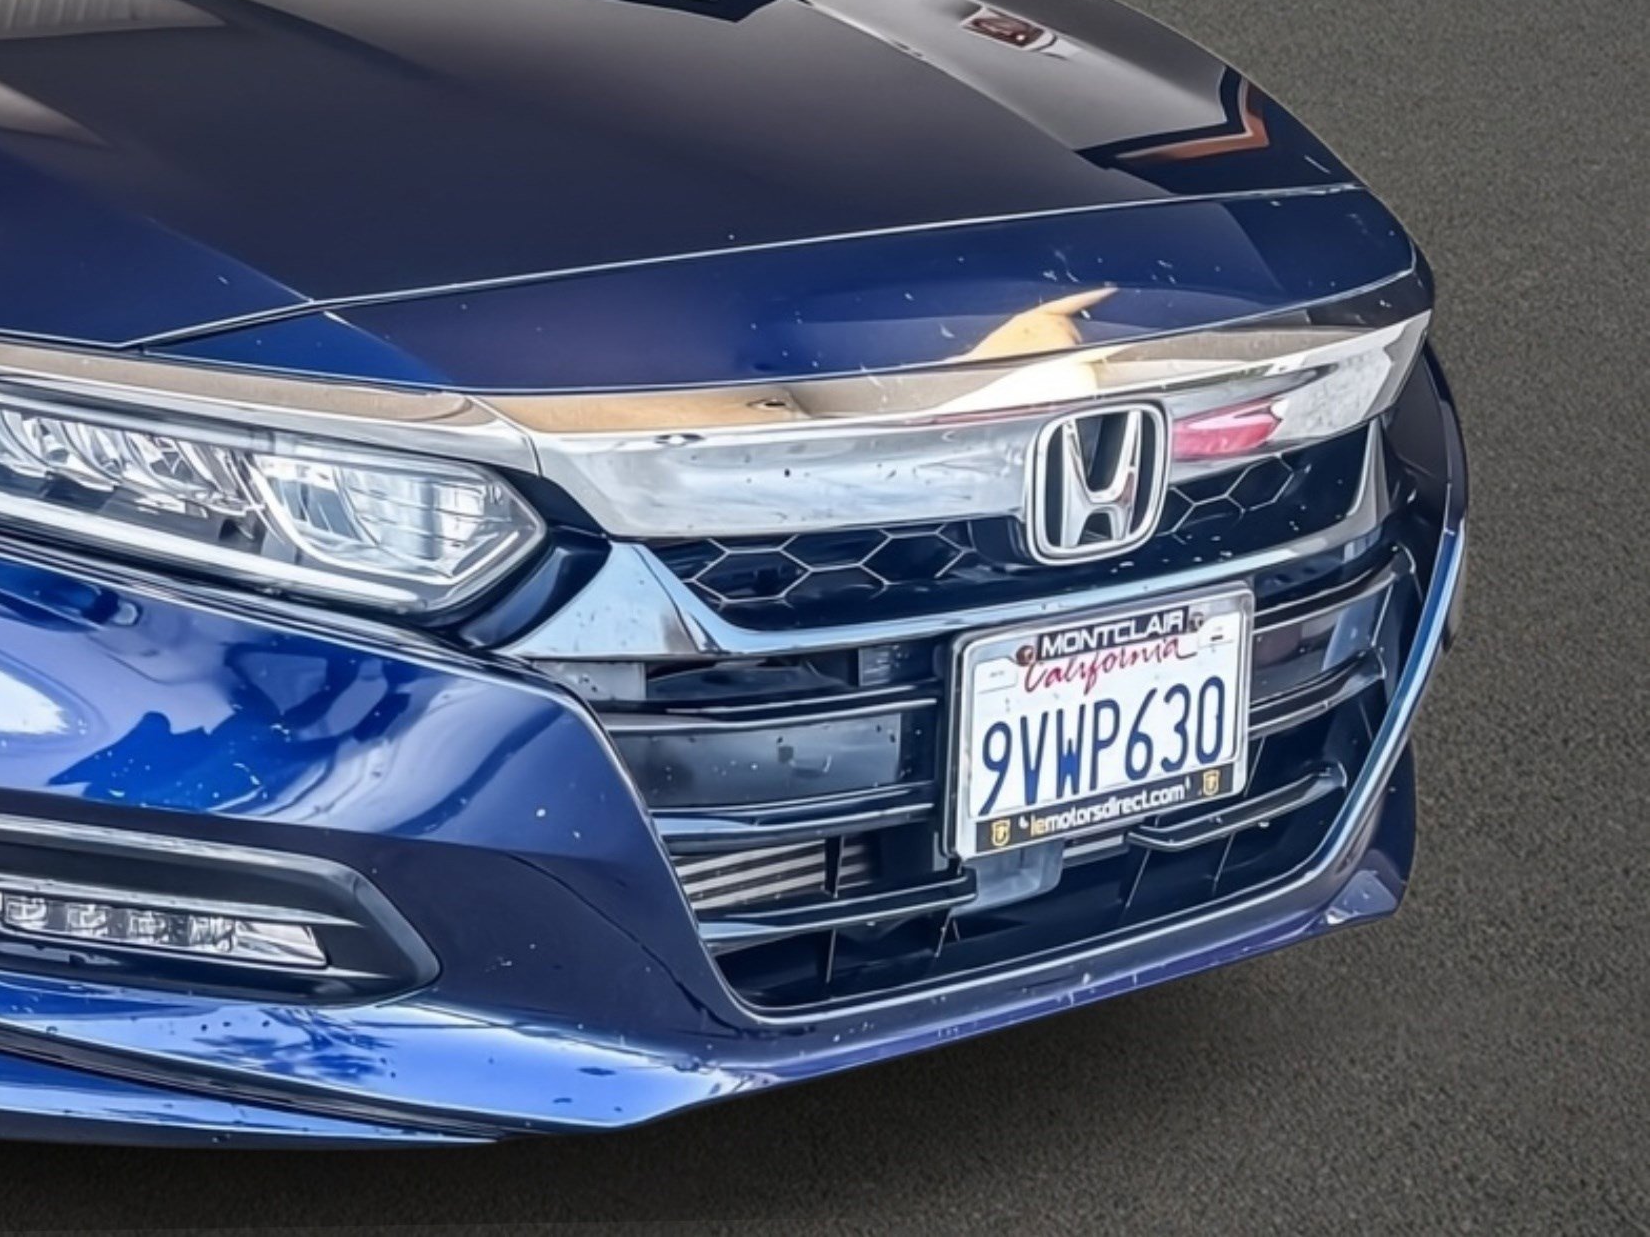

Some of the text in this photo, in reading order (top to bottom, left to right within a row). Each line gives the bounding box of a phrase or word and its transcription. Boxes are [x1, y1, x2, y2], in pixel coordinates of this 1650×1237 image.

[1040, 609, 1184, 658] MONTCLAIR
[1023, 637, 1198, 695] California
[977, 675, 1226, 817] 9VWP630
